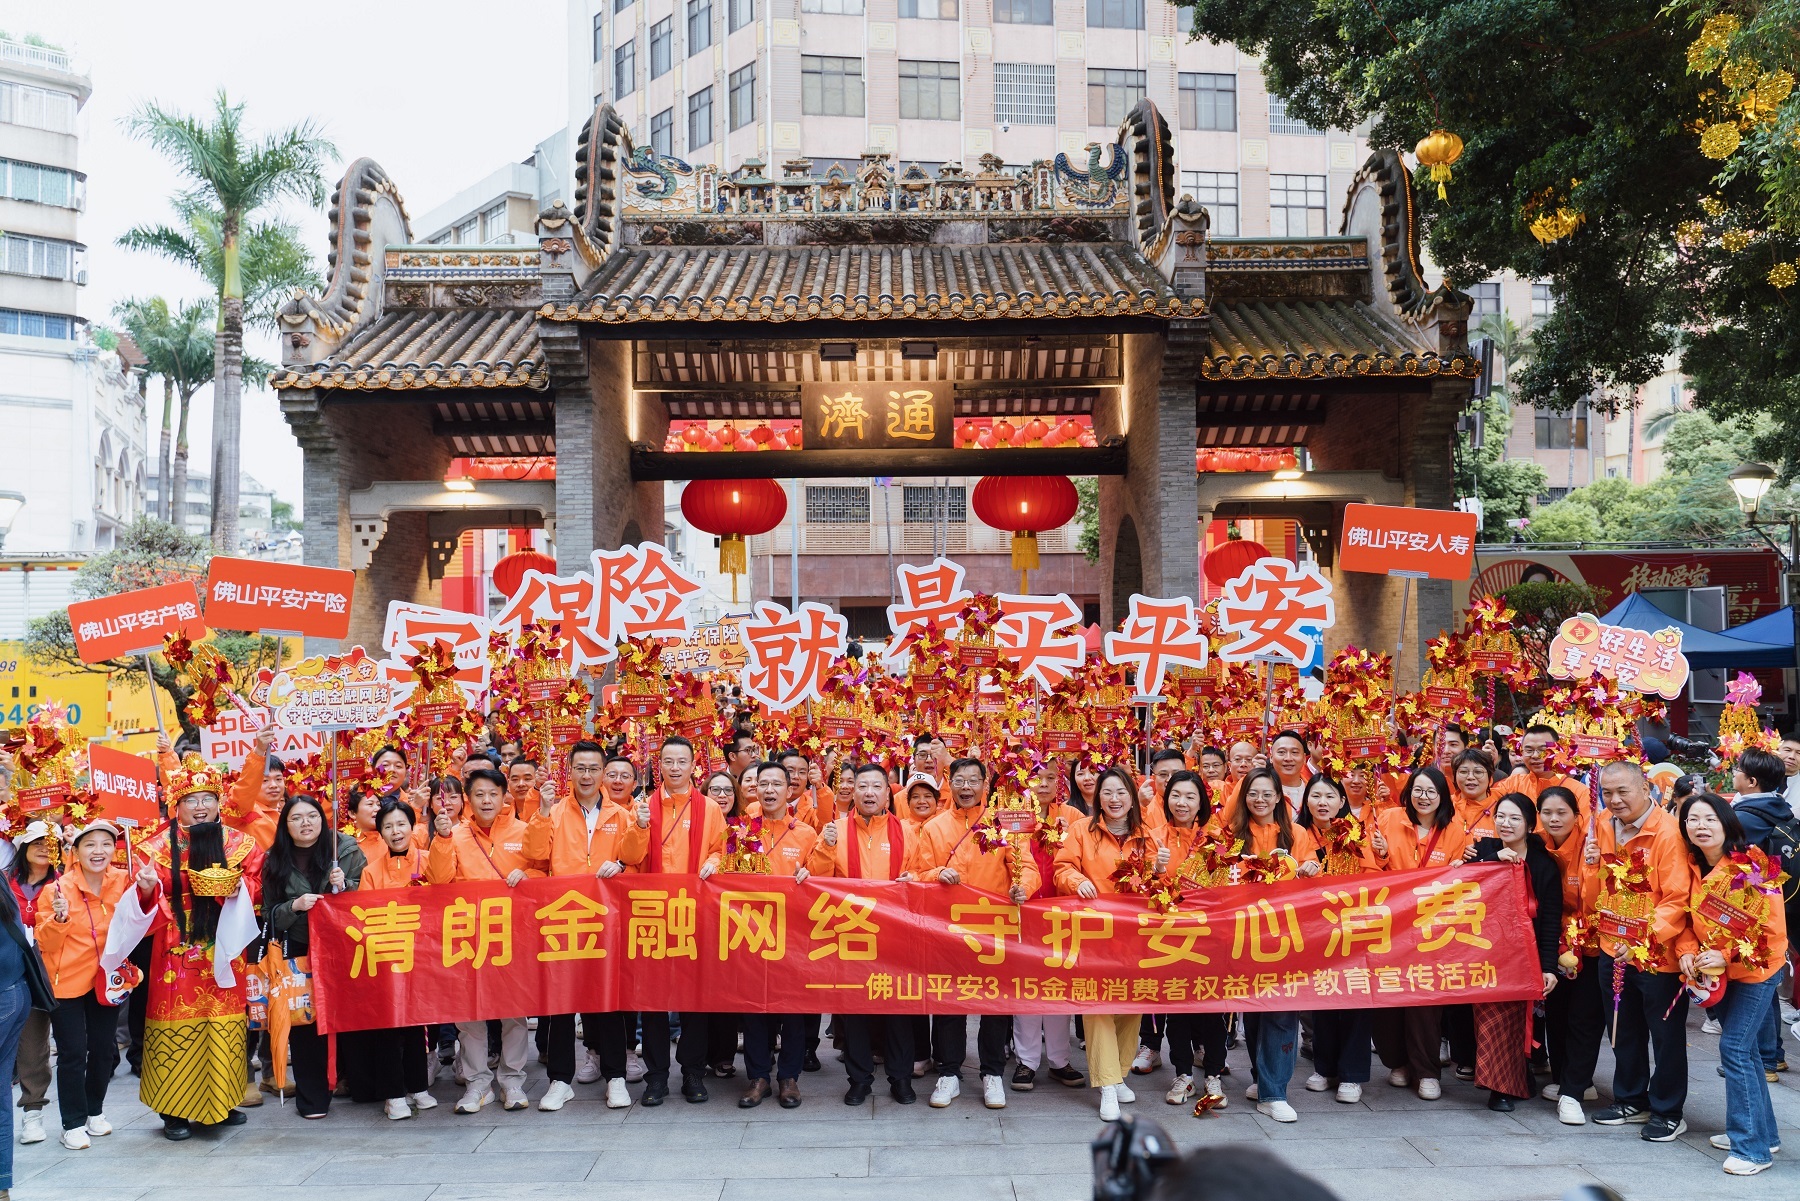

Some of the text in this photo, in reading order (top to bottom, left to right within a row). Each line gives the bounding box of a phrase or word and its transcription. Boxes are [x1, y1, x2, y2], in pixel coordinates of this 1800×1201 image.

[1347, 525, 1470, 556] 佛山平安人寿
[212, 580, 348, 615] 佛山平安产险
[78, 601, 198, 642] 佛山平安产险
[1562, 646, 1640, 687] 享平安
[1599, 628, 1678, 672] 好生活
[295, 687, 389, 707] 清朗金融网络
[286, 706, 381, 725] 守护安心消费
[93, 768, 157, 803] 佛山平安人寿
[345, 876, 1494, 978] 清朗金融网络 守护安心消费
